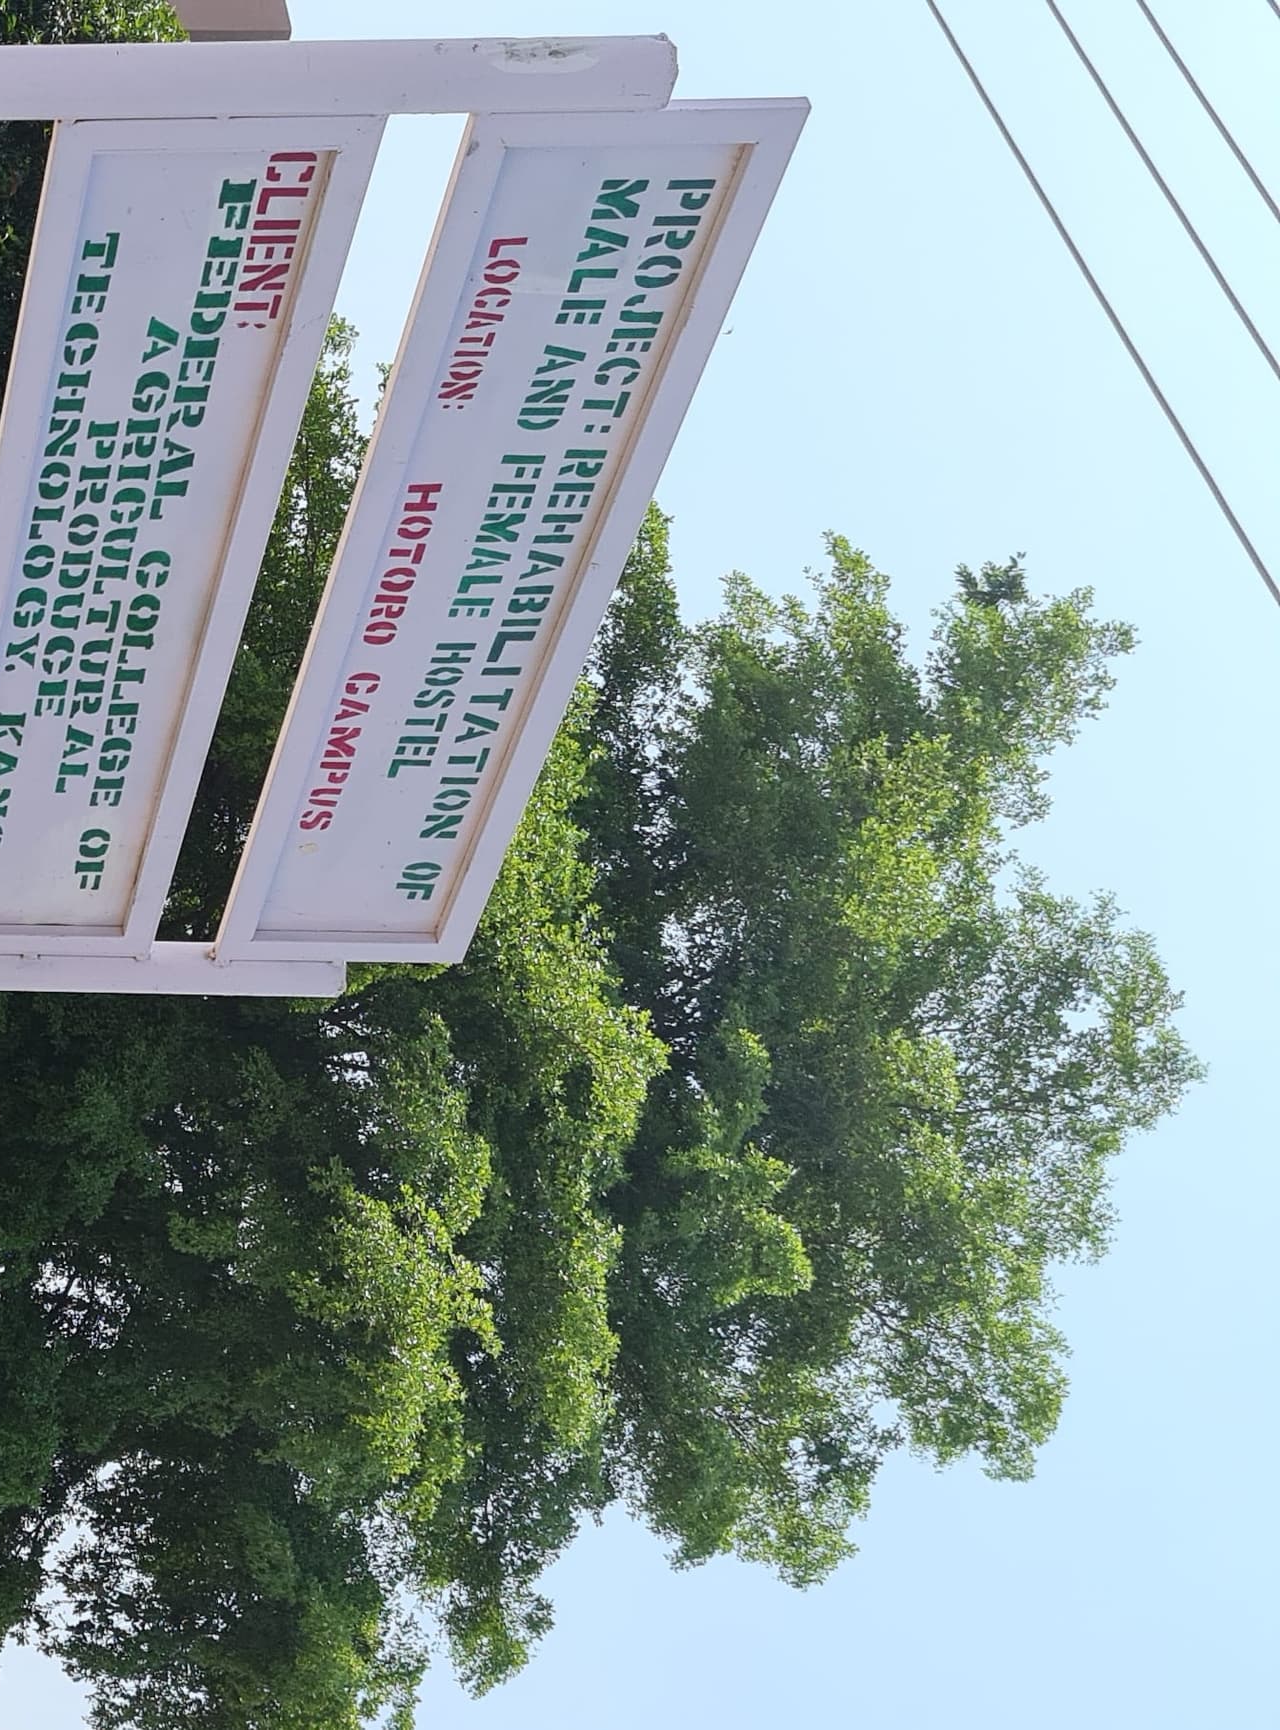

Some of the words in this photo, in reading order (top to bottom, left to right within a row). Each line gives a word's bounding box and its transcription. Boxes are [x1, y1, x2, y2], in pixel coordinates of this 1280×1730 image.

[234, 152, 318, 329] CLIENT:
[438, 237, 528, 410] LOCATION:
[555, 179, 650, 325] MALE
[582, 179, 716, 433] PROJECT:
[149, 178, 258, 520] FEDERAL
[517, 344, 587, 431] AND
[34, 421, 120, 717] PRODUCE
[55, 317, 180, 793] AGRICULTURAL
[363, 483, 443, 646] HOTORO
[448, 454, 546, 618] FEMALE
[89, 550, 171, 807] COLLEGE
[387, 642, 478, 779] HOSTEL
[419, 448, 608, 839] REHABILITATION
[299, 672, 380, 831] CAMPUS
[74, 828, 111, 890] OF
[396, 862, 443, 901] OF
